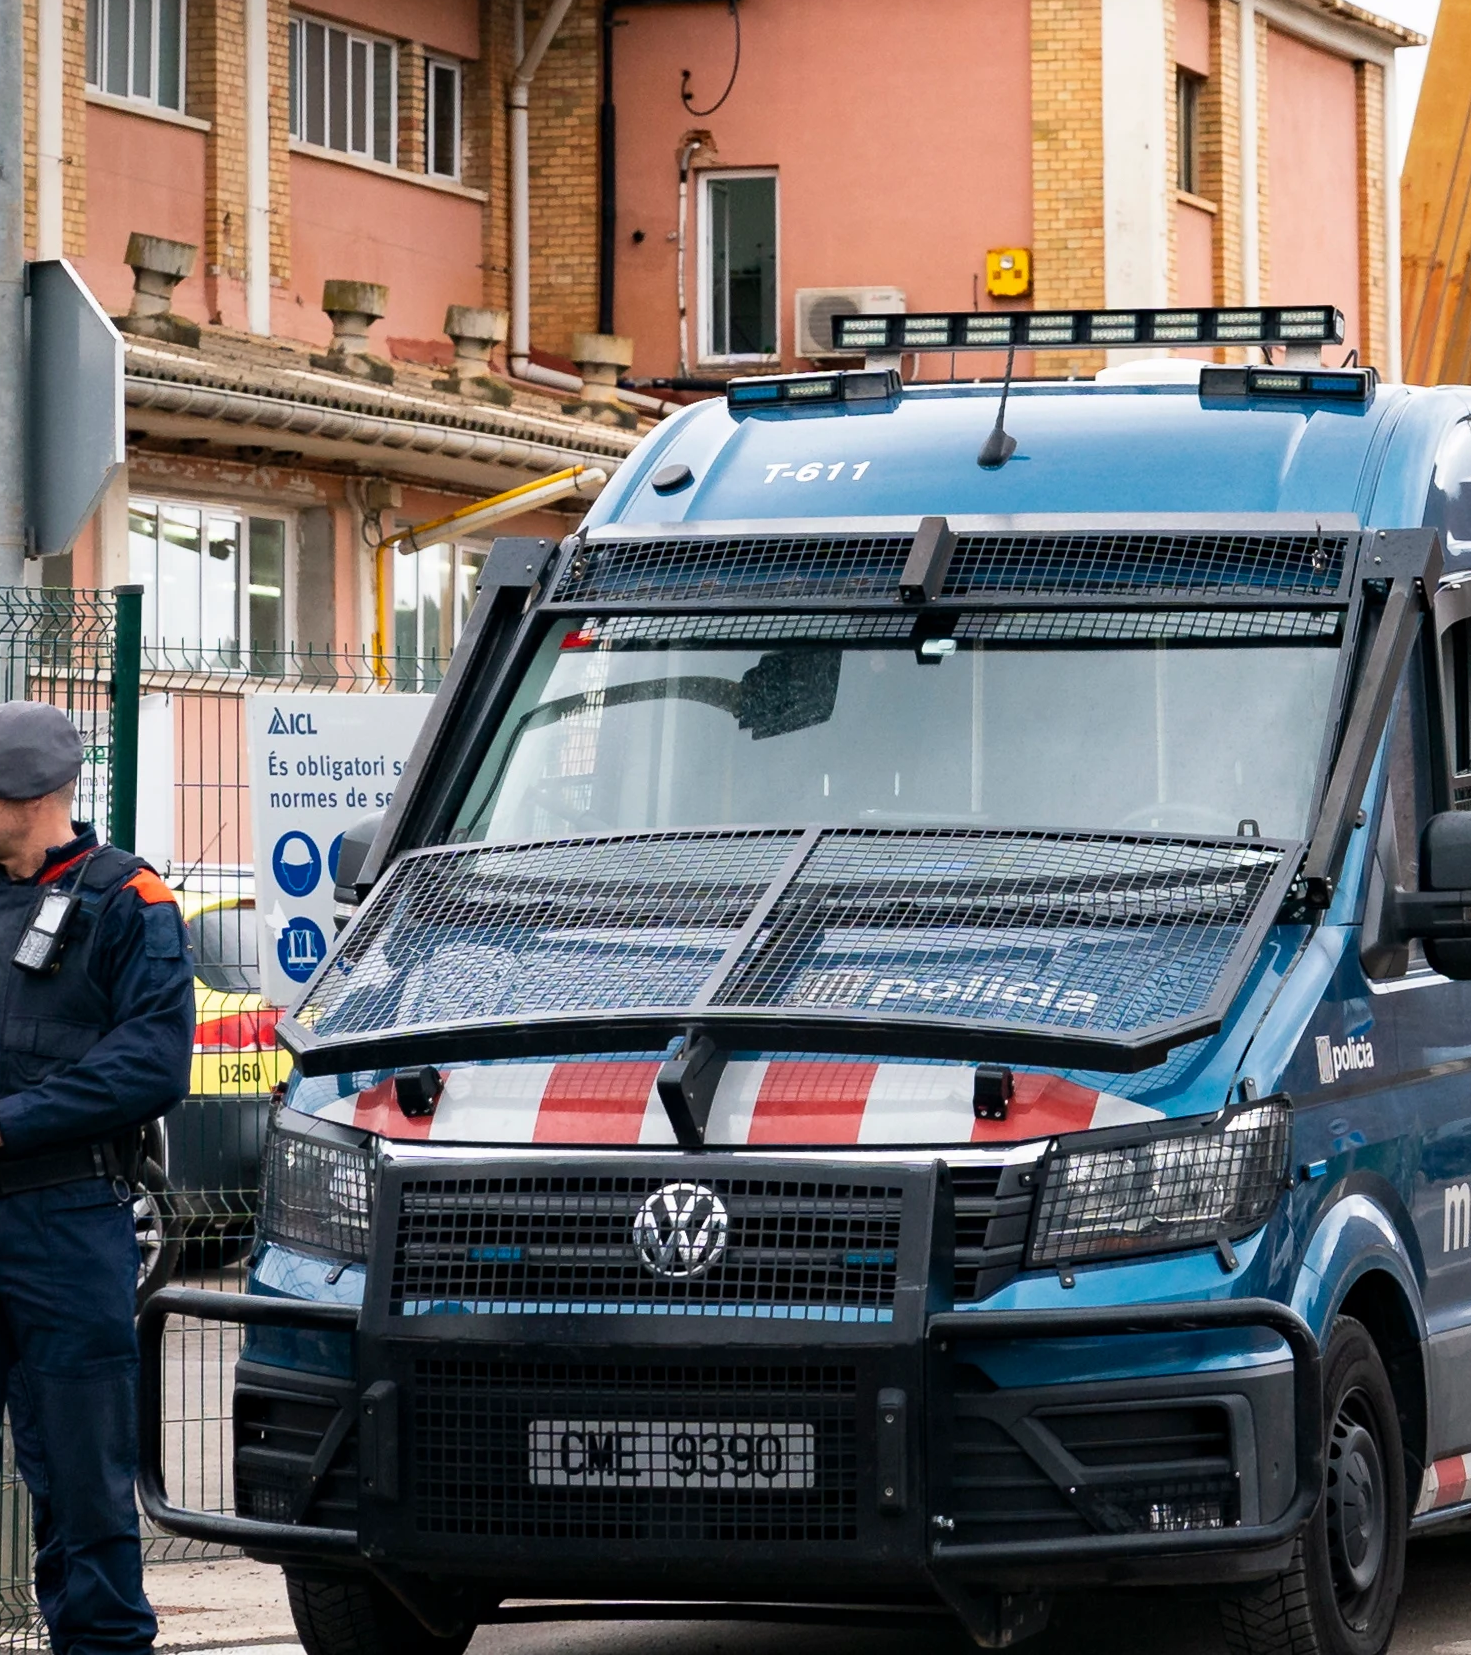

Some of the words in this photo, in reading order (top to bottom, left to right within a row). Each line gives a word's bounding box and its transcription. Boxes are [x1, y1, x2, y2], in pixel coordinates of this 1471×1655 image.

[763, 461, 871, 484] T-611
[289, 713, 317, 735] ICL
[268, 750, 288, 776] És
[297, 755, 385, 781] obligatori
[393, 759, 408, 776] s
[270, 792, 337, 808] normes
[346, 787, 367, 807] de
[375, 792, 394, 807] se
[868, 975, 1099, 1012] policia
[1332, 1035, 1374, 1079] policia
[219, 1063, 261, 1083] 0260
[560, 1430, 642, 1477] CME
[671, 1432, 783, 1478] 9390
